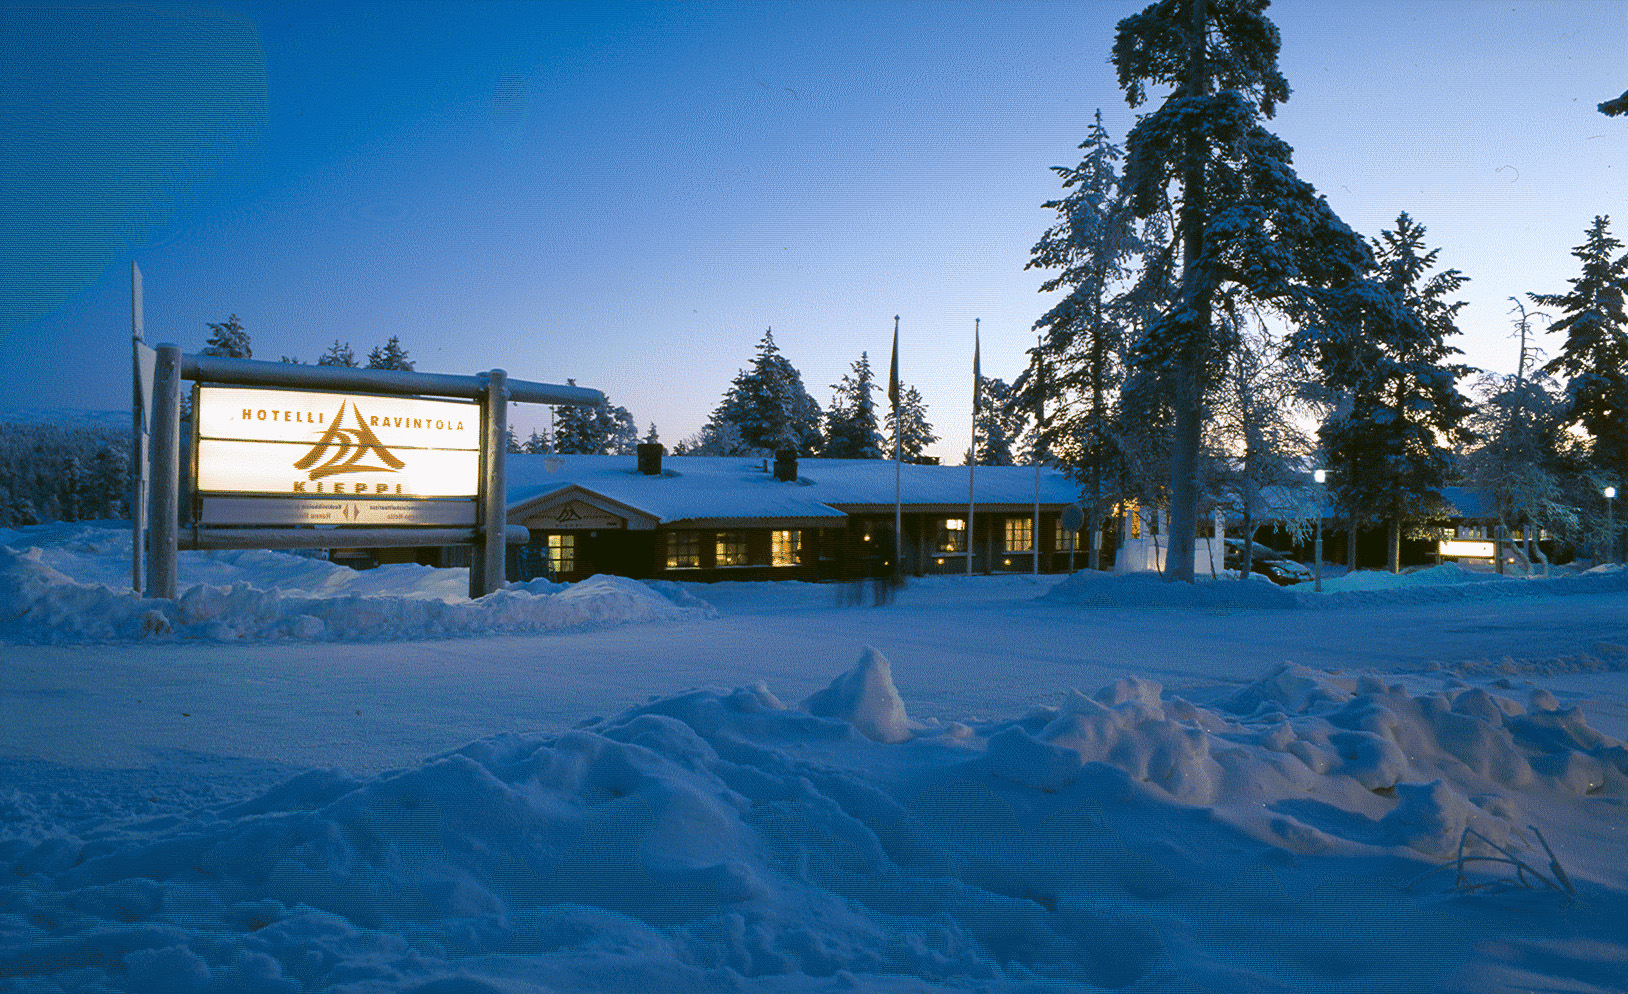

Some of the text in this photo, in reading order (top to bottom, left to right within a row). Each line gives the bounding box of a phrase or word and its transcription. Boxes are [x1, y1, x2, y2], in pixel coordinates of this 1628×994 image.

[242, 408, 464, 431] HOTELLI RAVINTOLA
[293, 481, 402, 494] KIEPPI
